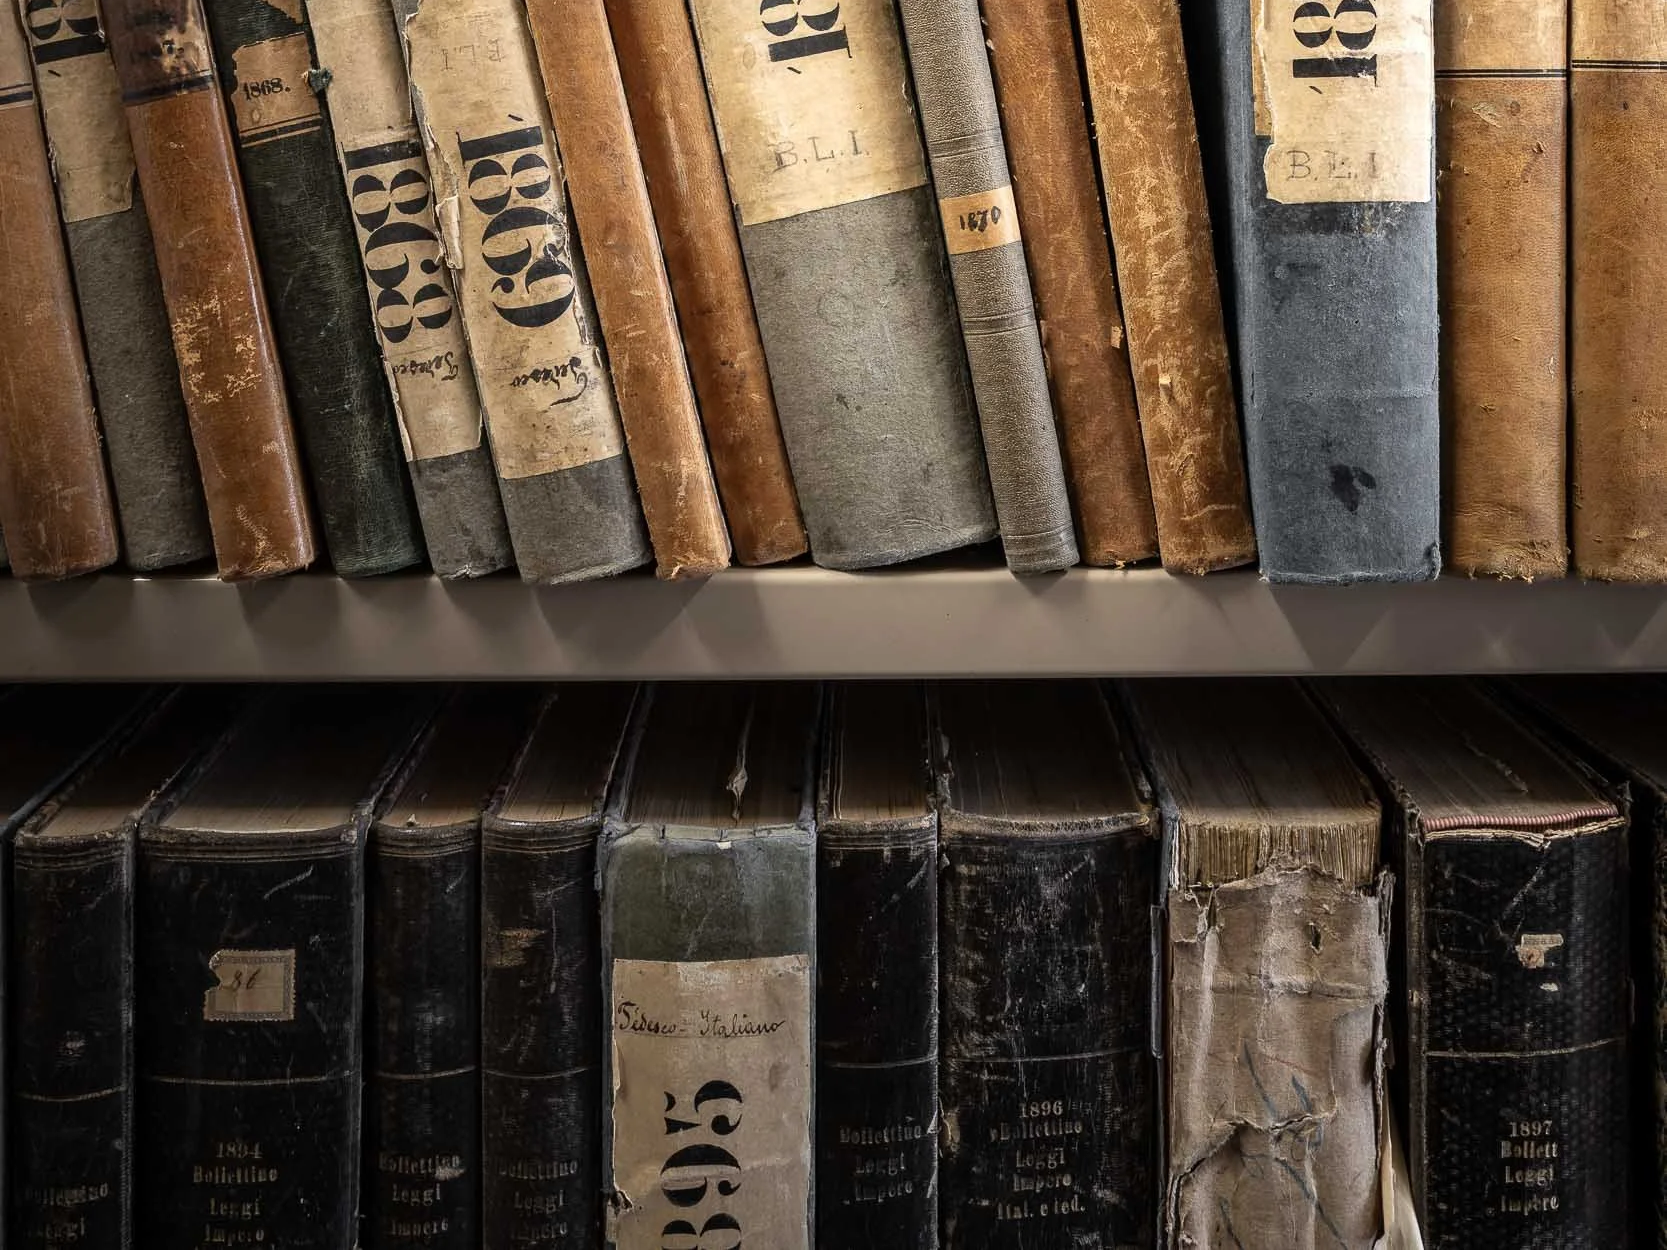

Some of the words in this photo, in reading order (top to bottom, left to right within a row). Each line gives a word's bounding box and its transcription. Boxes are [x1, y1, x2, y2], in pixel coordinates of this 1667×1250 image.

[243, 77, 291, 100] 1868.
[456, 114, 575, 328] 1869
[959, 205, 1002, 233] 1870
[341, 139, 453, 344] 1868
[1019, 1100, 1064, 1118] 1896
[1508, 1120, 1553, 1138] 1897
